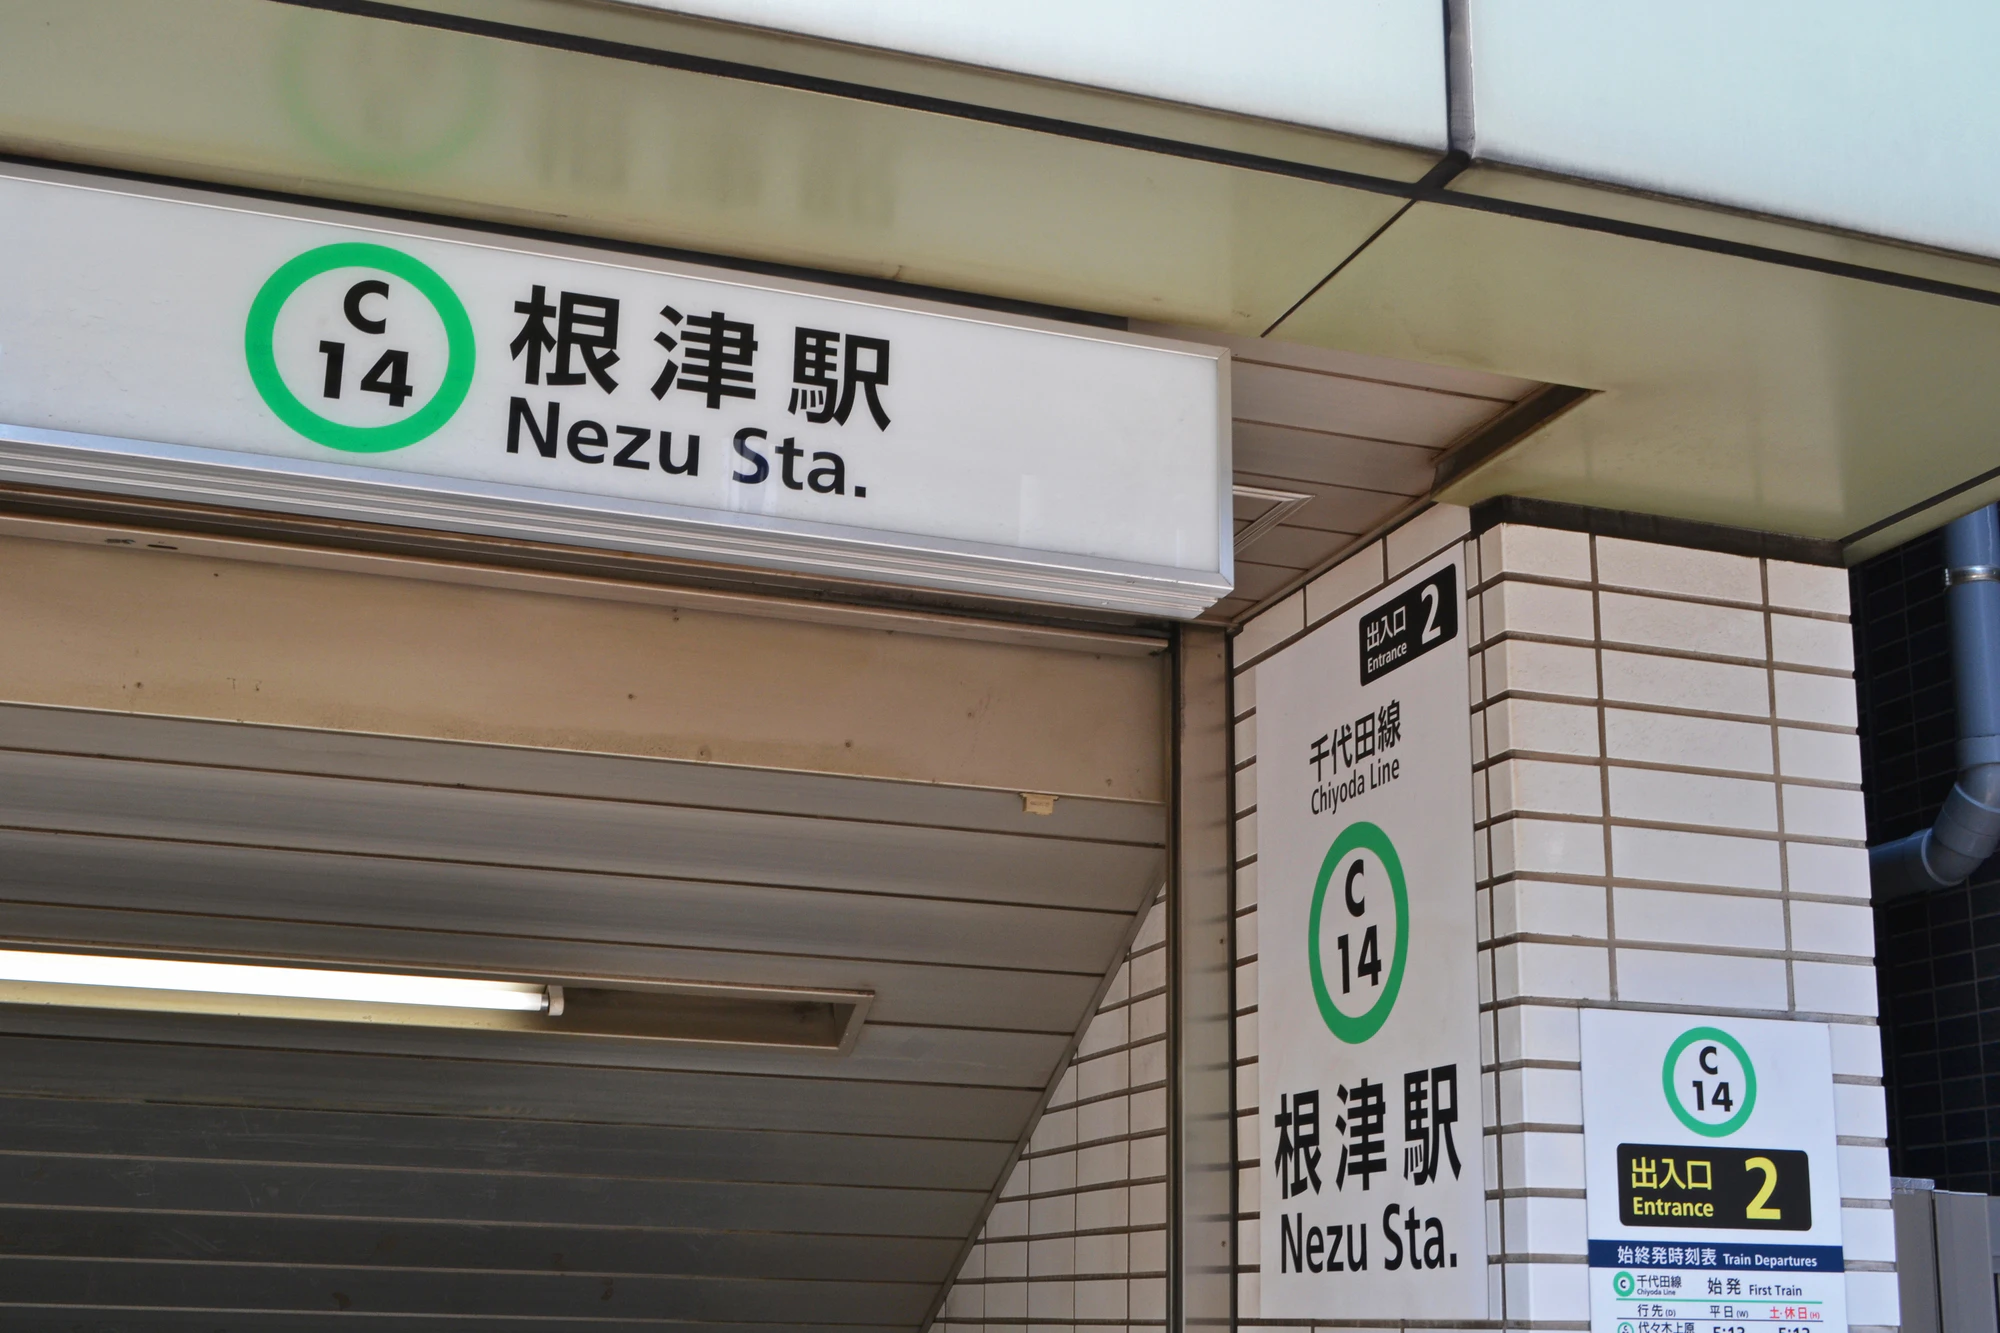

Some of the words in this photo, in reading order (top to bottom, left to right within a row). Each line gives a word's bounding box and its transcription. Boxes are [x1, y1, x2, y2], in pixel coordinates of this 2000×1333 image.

[343, 280, 389, 334] C
[318, 340, 413, 408] 14
[510, 285, 891, 432] 根津駅
[506, 397, 700, 476] Nezu
[731, 427, 867, 498] Sta.
[1366, 606, 1406, 652] 出入口
[1421, 584, 1442, 645] 2
[1367, 642, 1408, 674] Entrance
[1309, 699, 1401, 782] 千代田線
[1311, 769, 1365, 815] Chiyoda
[1370, 757, 1400, 789] Line
[1345, 859, 1365, 917] C
[1337, 925, 1382, 995] 14
[1699, 1046, 1719, 1075] C
[1692, 1080, 1733, 1112] 14
[1274, 1063, 1462, 1199] 根津駅
[1631, 1157, 1712, 1190] 出入口
[1745, 1157, 1781, 1220] 2
[1633, 1197, 1714, 1218] Entrance
[1280, 1212, 1368, 1275] Nezu
[1382, 1203, 1457, 1271] Sta.
[1617, 1246, 1717, 1267] 始終発時刻表
[1723, 1253, 1751, 1266] Train
[1754, 1253, 1818, 1268] Departures
[1620, 1279, 1627, 1289] C
[1637, 1275, 1682, 1288] 千代田線
[1637, 1288, 1662, 1297] Chiyoda
[1707, 1277, 1741, 1295] 始発
[1749, 1284, 1772, 1296] First
[1775, 1285, 1802, 1296] Train
[1637, 1304, 1663, 1317] 行先
[1665, 1309, 1676, 1317] (D)
[1710, 1305, 1733, 1318] 平日
[1736, 1310, 1749, 1318] (W)
[1810, 1311, 1820, 1319] (H)
